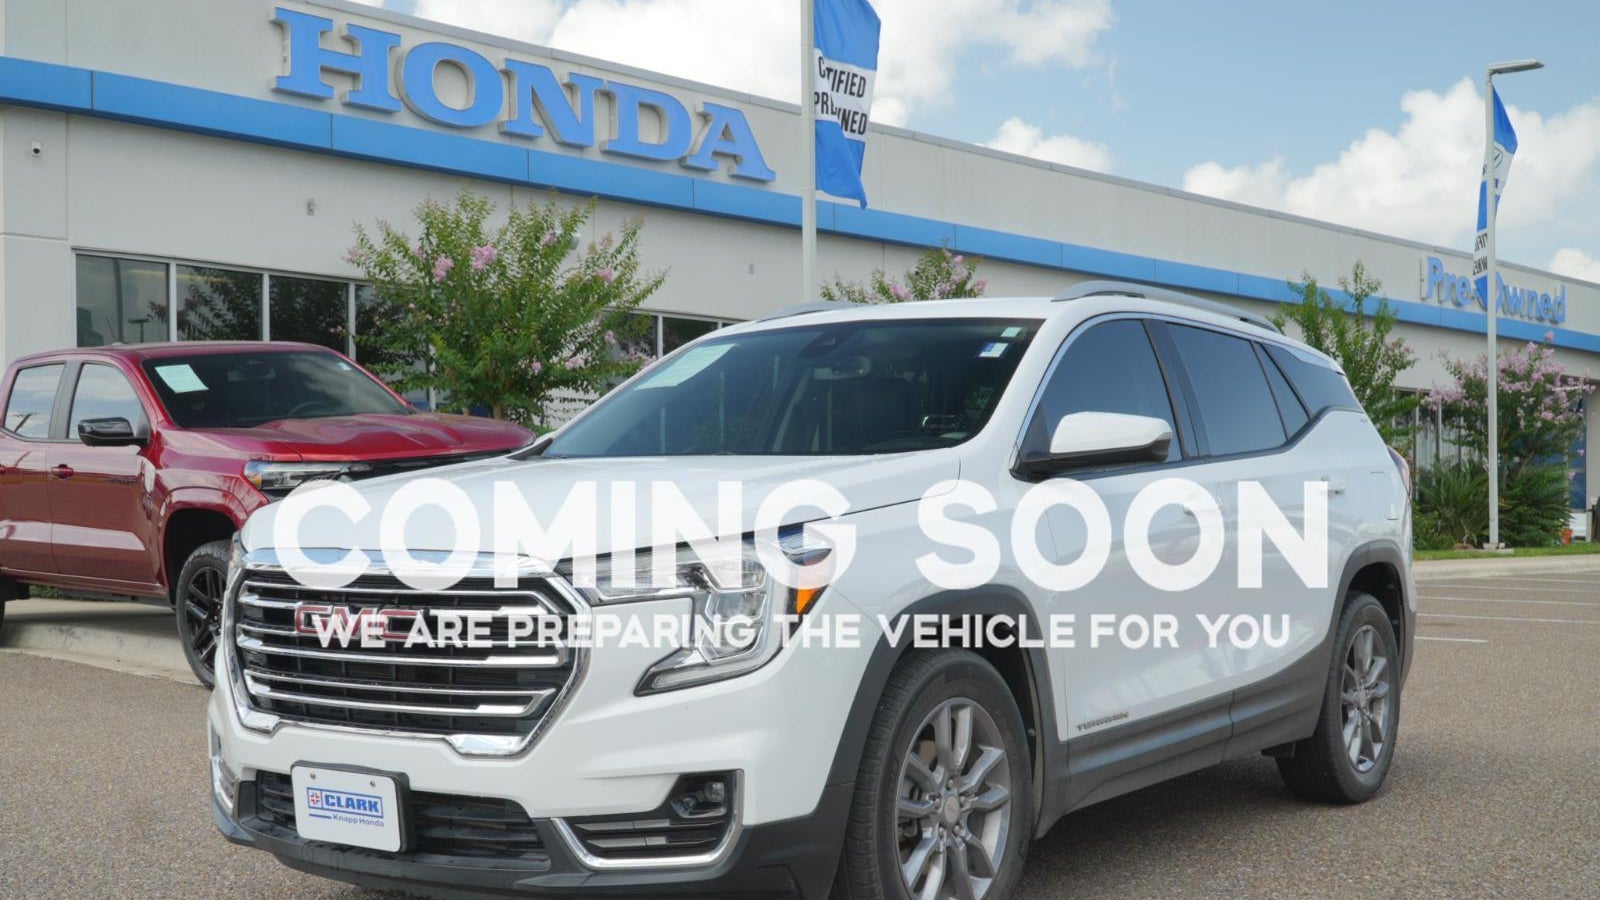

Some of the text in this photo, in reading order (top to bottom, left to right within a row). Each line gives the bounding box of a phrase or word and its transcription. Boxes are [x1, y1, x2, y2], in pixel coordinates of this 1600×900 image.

[270, 7, 776, 182] HONDA
[294, 604, 424, 642] GMC
[324, 794, 379, 813] CLARK
[332, 813, 385, 828] Knapp Honda
